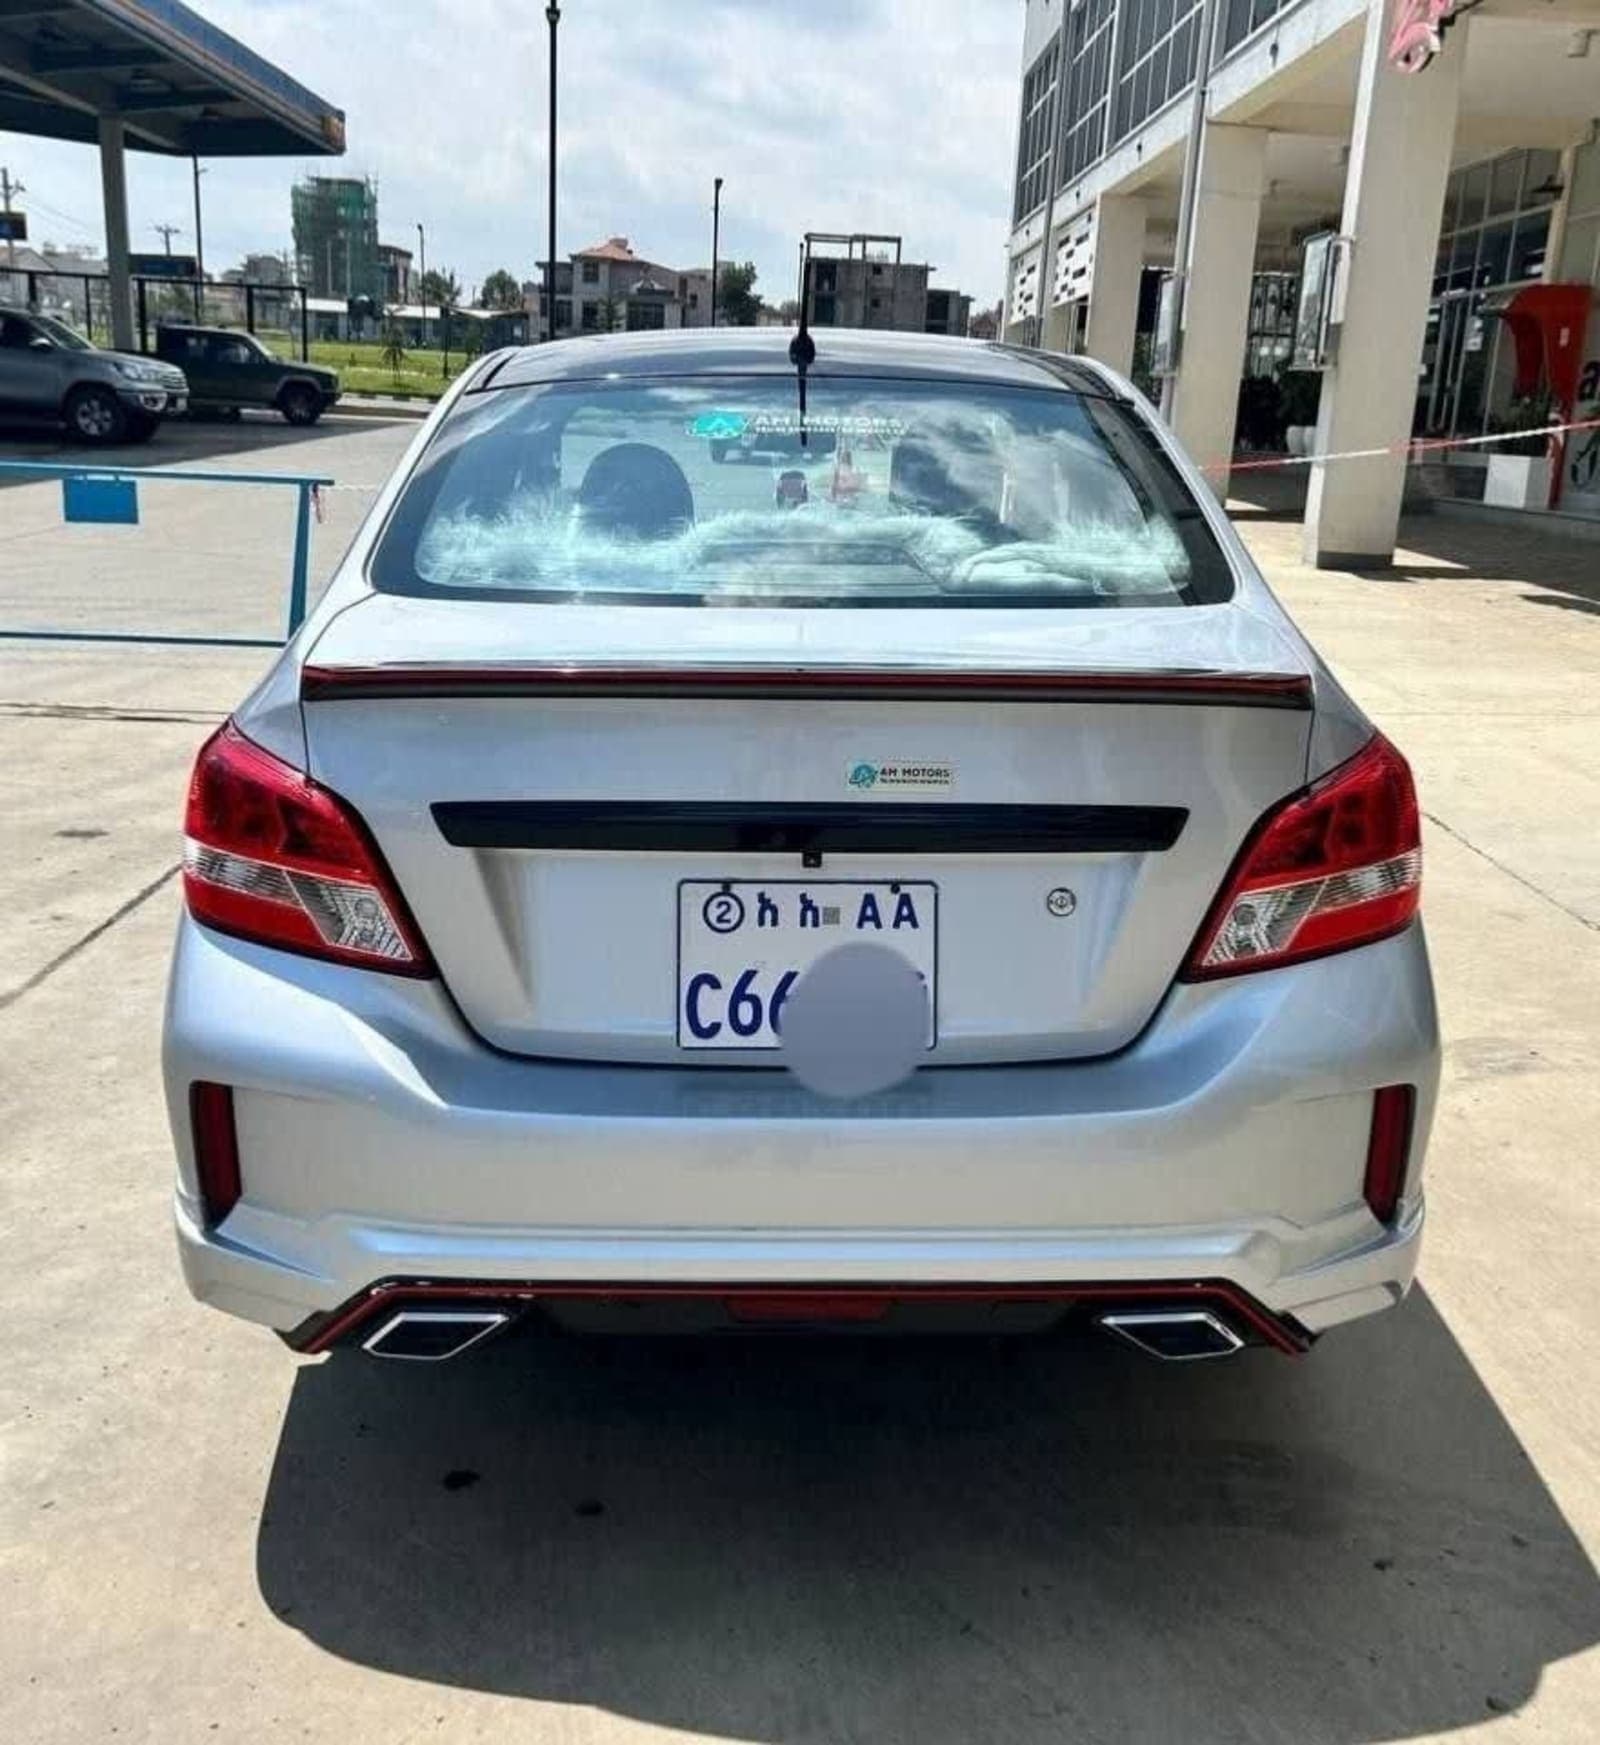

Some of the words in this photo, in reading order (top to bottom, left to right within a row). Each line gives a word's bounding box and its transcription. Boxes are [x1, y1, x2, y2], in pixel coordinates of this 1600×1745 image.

[756, 415, 789, 427] AM
[879, 767, 897, 777] AM
[902, 767, 951, 778] MOTORS
[856, 893, 919, 929] AA
